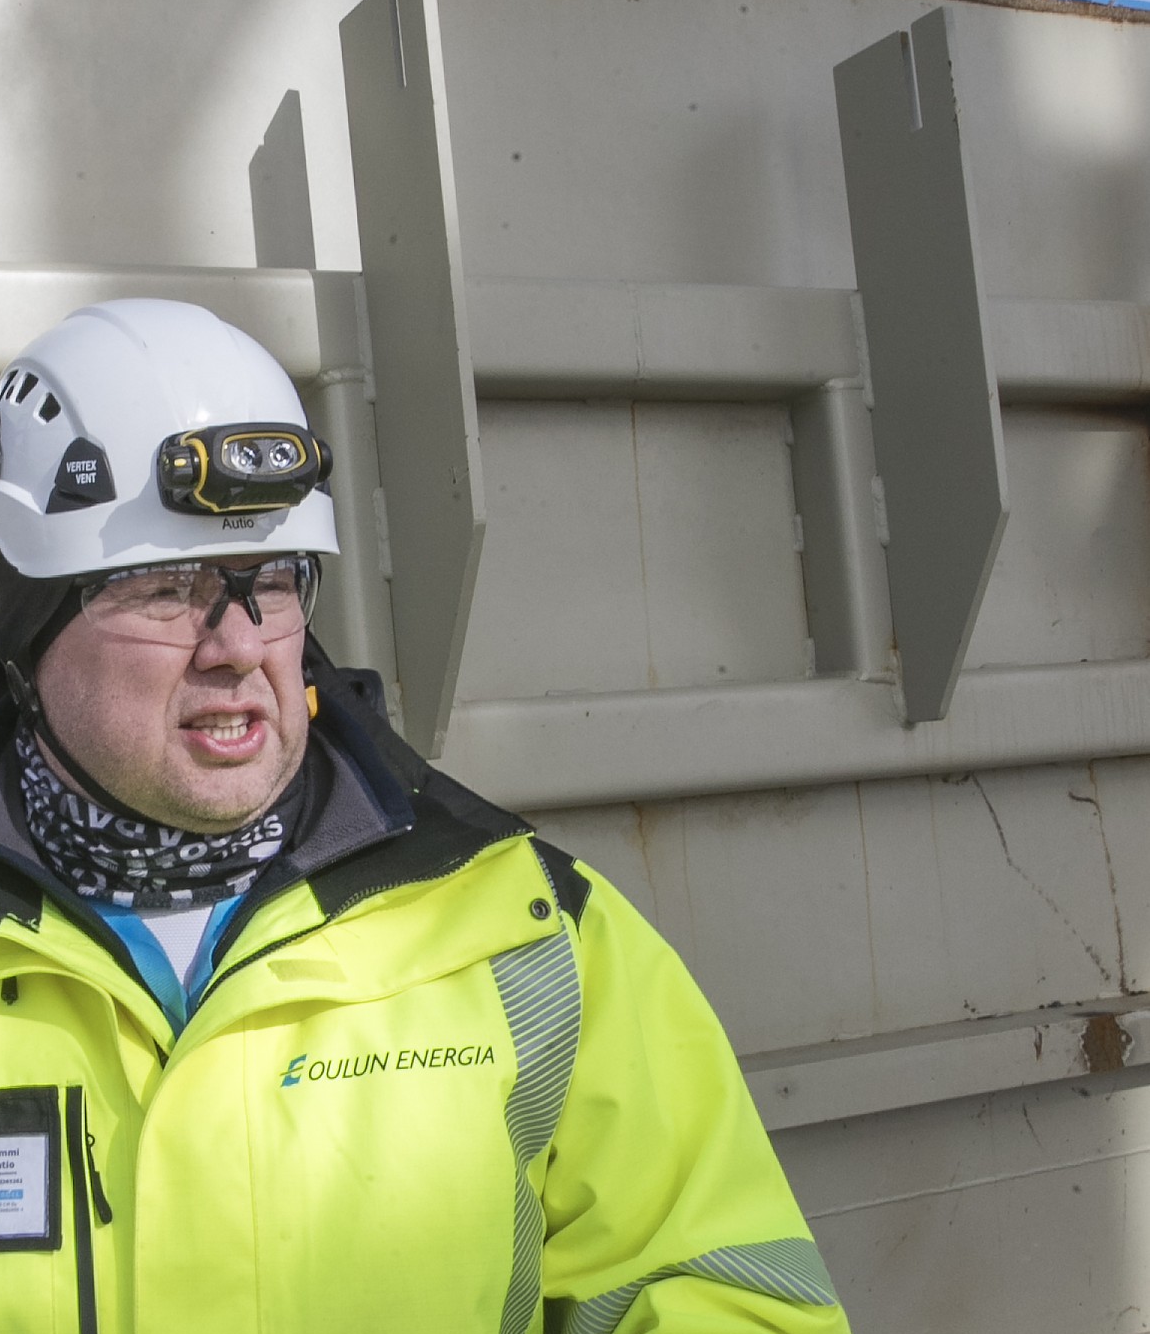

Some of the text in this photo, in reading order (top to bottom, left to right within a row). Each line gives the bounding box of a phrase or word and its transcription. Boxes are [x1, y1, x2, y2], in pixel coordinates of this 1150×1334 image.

[66, 460, 97, 473] VERTEX
[76, 472, 97, 484] VENT
[222, 517, 255, 530] Autio
[308, 1052, 389, 1080] OULUN
[396, 1046, 495, 1070] ENERGIA
